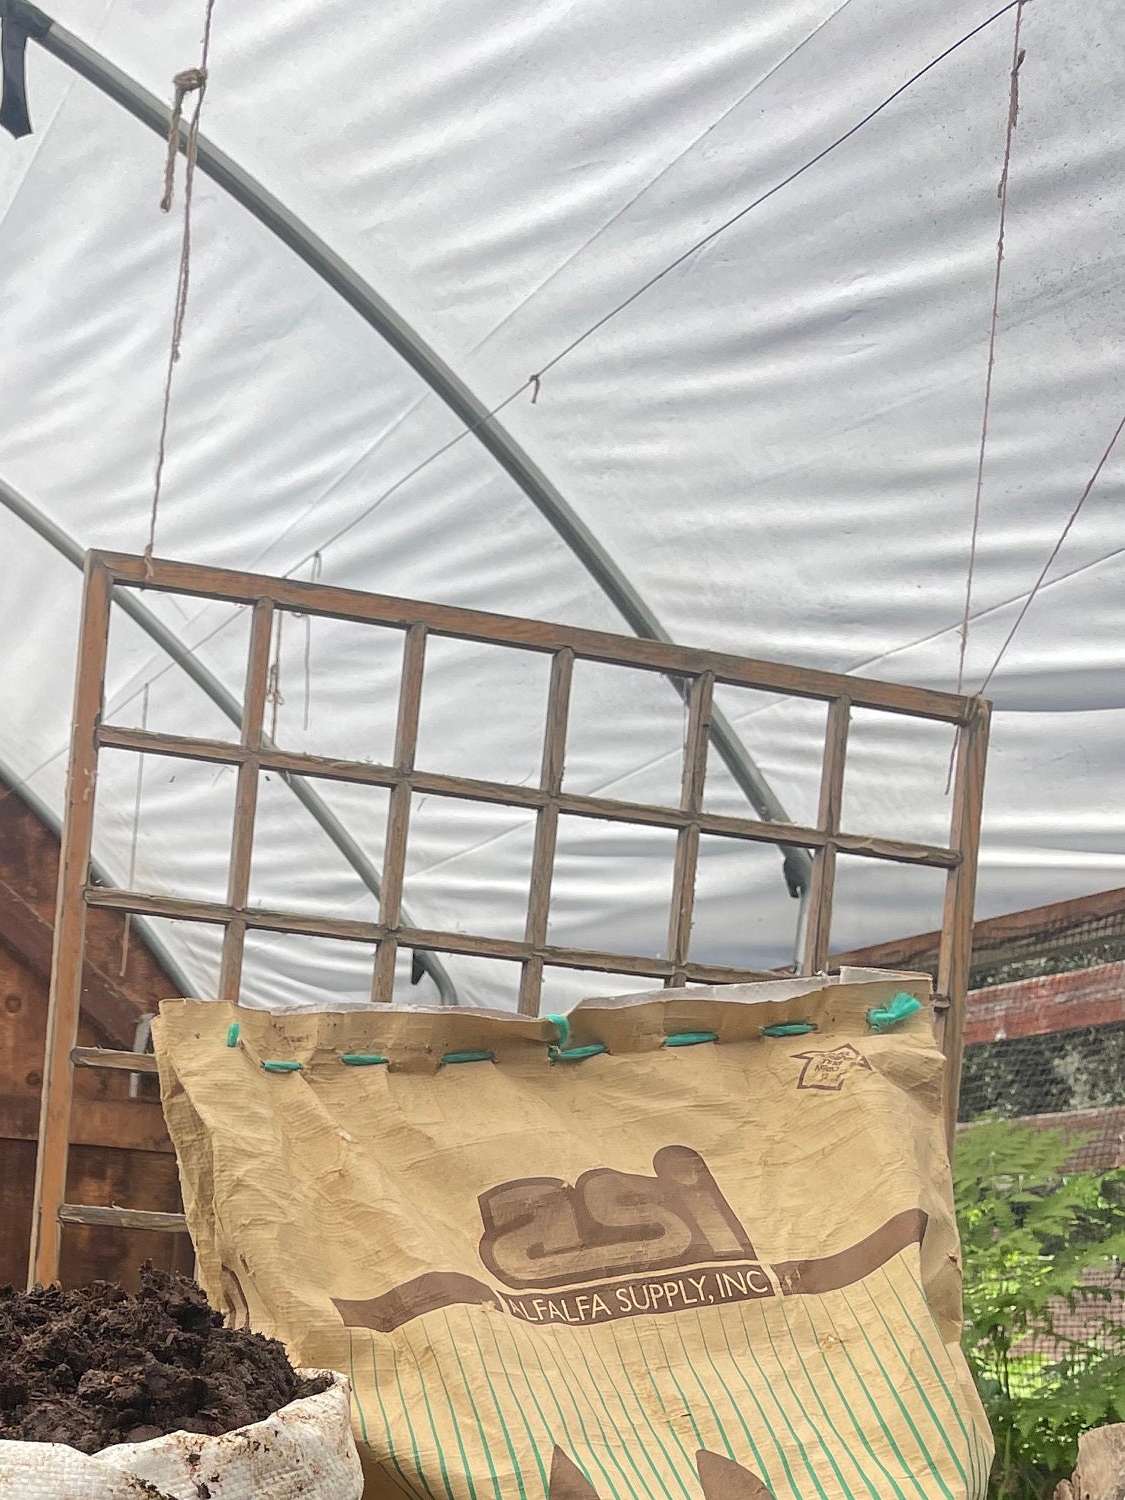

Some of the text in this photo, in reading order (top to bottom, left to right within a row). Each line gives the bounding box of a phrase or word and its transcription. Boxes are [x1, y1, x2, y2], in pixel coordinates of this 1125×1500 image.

[508, 1270, 768, 1322] ALFALFA SUPPLY, INC
